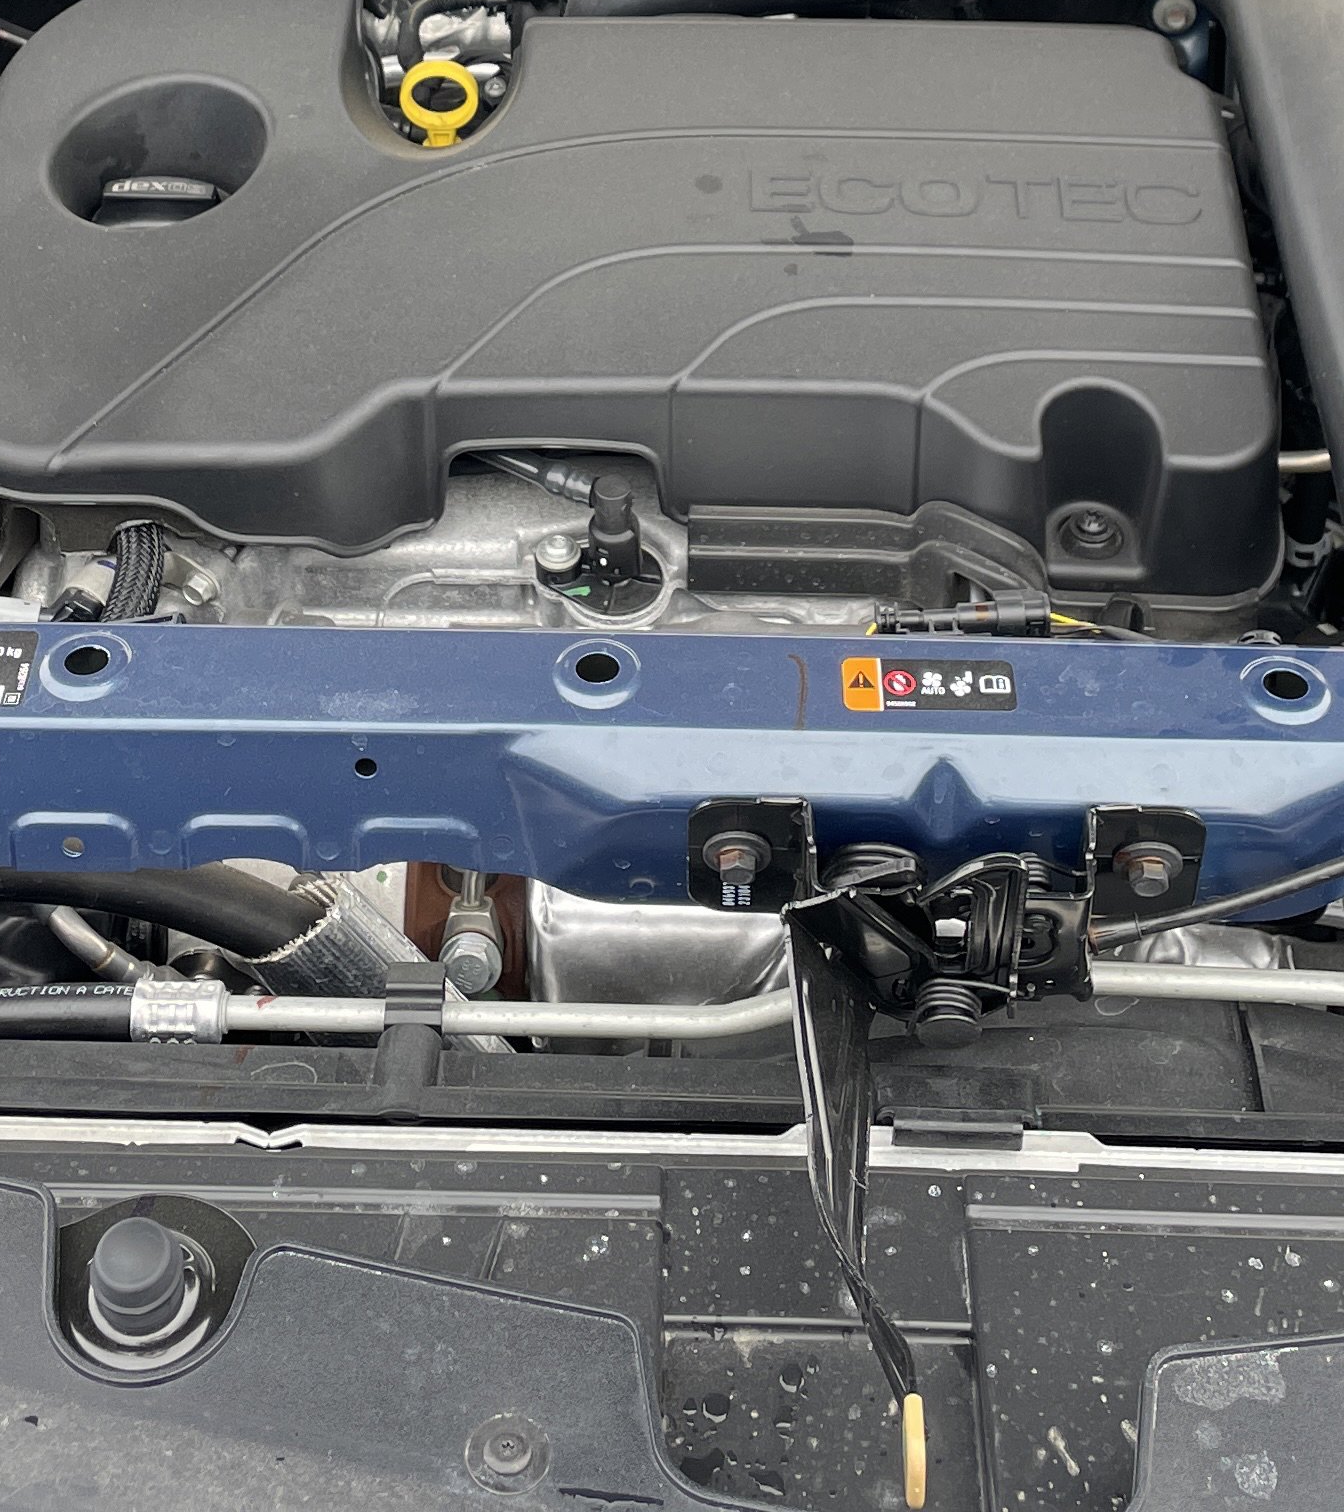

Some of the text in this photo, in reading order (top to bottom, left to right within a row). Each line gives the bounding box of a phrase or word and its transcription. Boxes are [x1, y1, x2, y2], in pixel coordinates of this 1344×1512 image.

[748, 168, 1204, 226] ECOTEC
[6, 645, 23, 659] kg
[920, 686, 946, 696] AUTO
[75, 984, 86, 995] A
